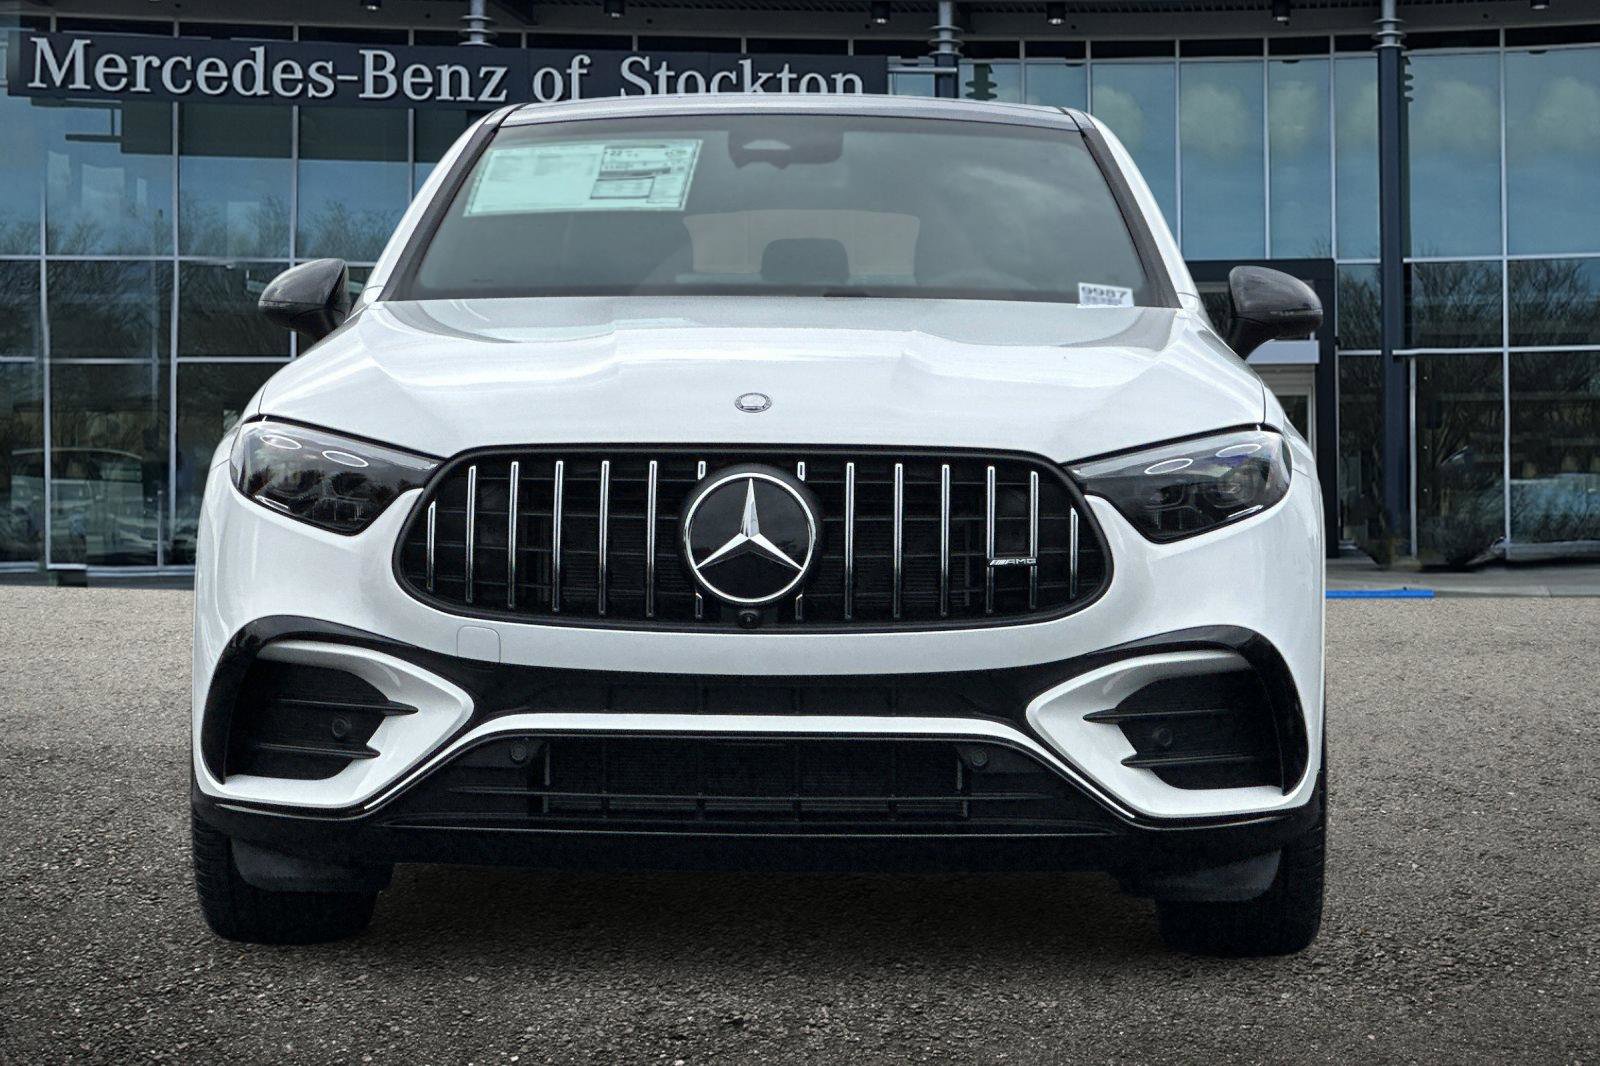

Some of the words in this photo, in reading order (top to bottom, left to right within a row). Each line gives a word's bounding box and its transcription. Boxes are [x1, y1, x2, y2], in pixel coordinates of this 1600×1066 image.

[27, 36, 509, 102] Mercedes-Benz
[532, 54, 592, 102] of
[619, 55, 864, 99] Stockton
